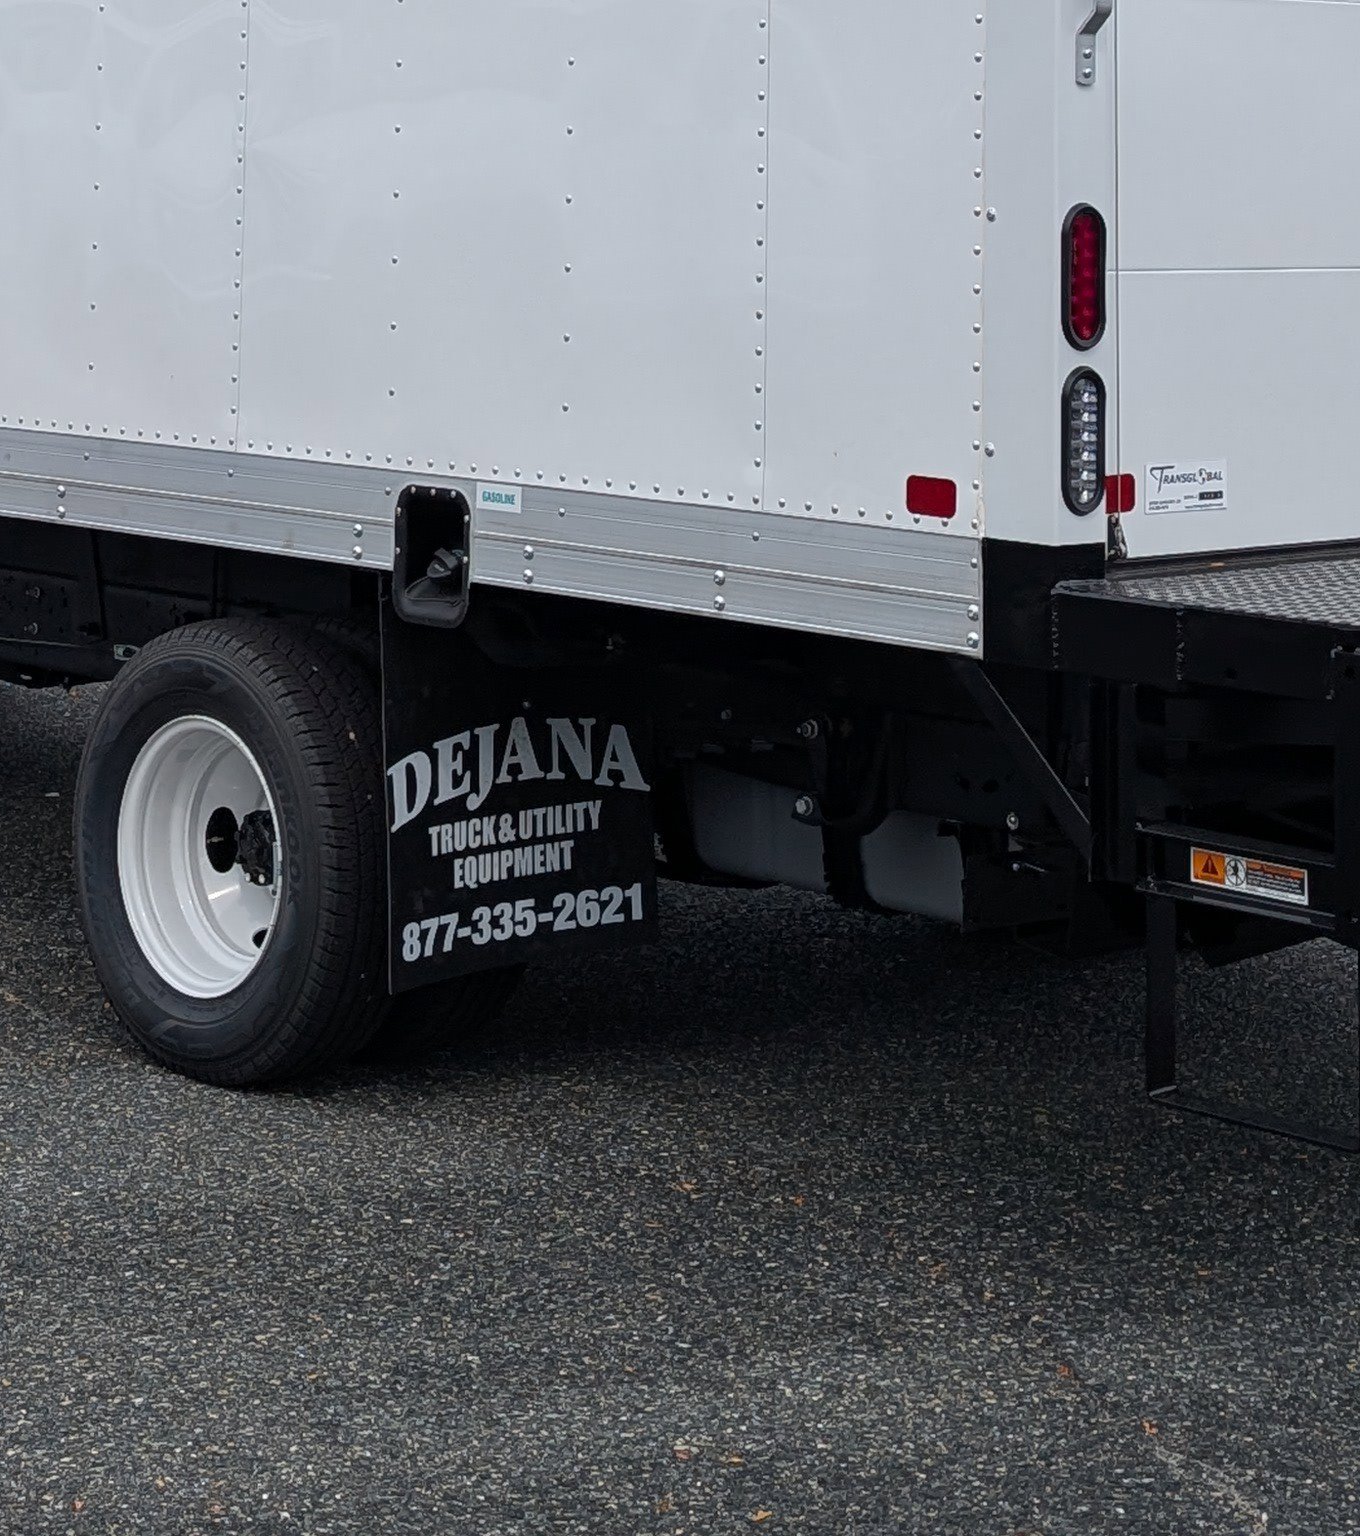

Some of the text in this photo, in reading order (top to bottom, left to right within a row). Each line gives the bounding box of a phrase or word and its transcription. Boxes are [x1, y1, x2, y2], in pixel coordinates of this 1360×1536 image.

[482, 490, 516, 506] GASOLINE
[387, 716, 651, 834] DEJANA
[453, 839, 575, 890] EQUIPMENT
[401, 882, 644, 963] 877-335-2621
